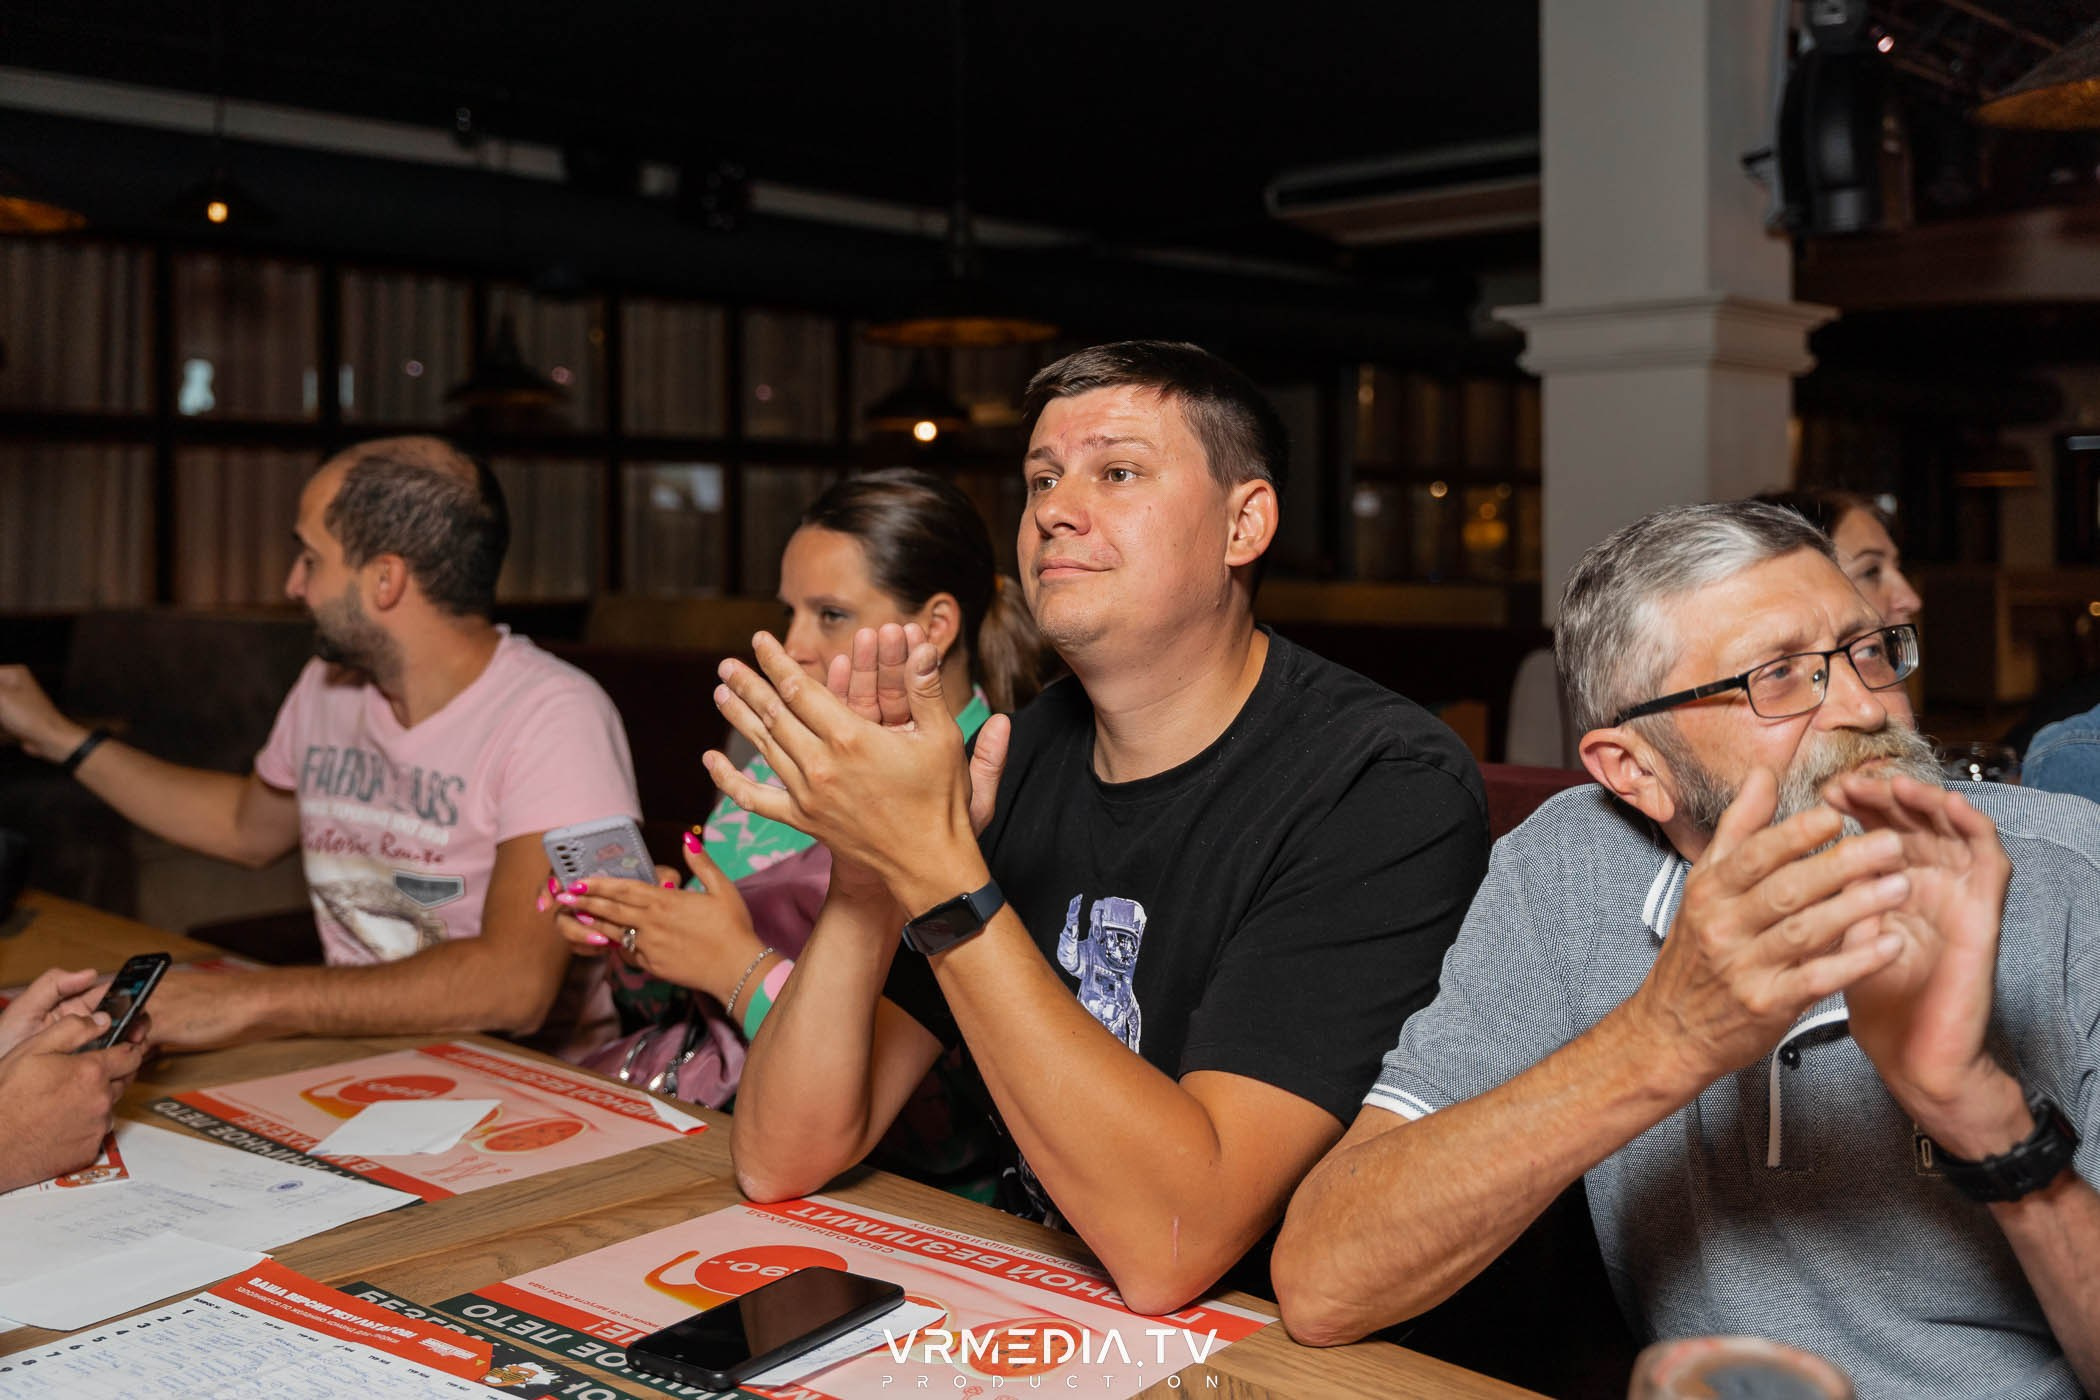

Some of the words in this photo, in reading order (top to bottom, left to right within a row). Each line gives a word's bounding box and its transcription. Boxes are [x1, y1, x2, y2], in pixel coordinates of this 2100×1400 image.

[154, 1102, 220, 1128] ЛЕТО
[746, 1208, 791, 1224] ВХОД
[787, 1206, 1010, 1269] БЕЗЛИМИТ
[790, 1222, 894, 1254] СВОБОДНЫЙ
[548, 1287, 574, 1300] 2024
[462, 1304, 574, 1345] ЛЕТО
